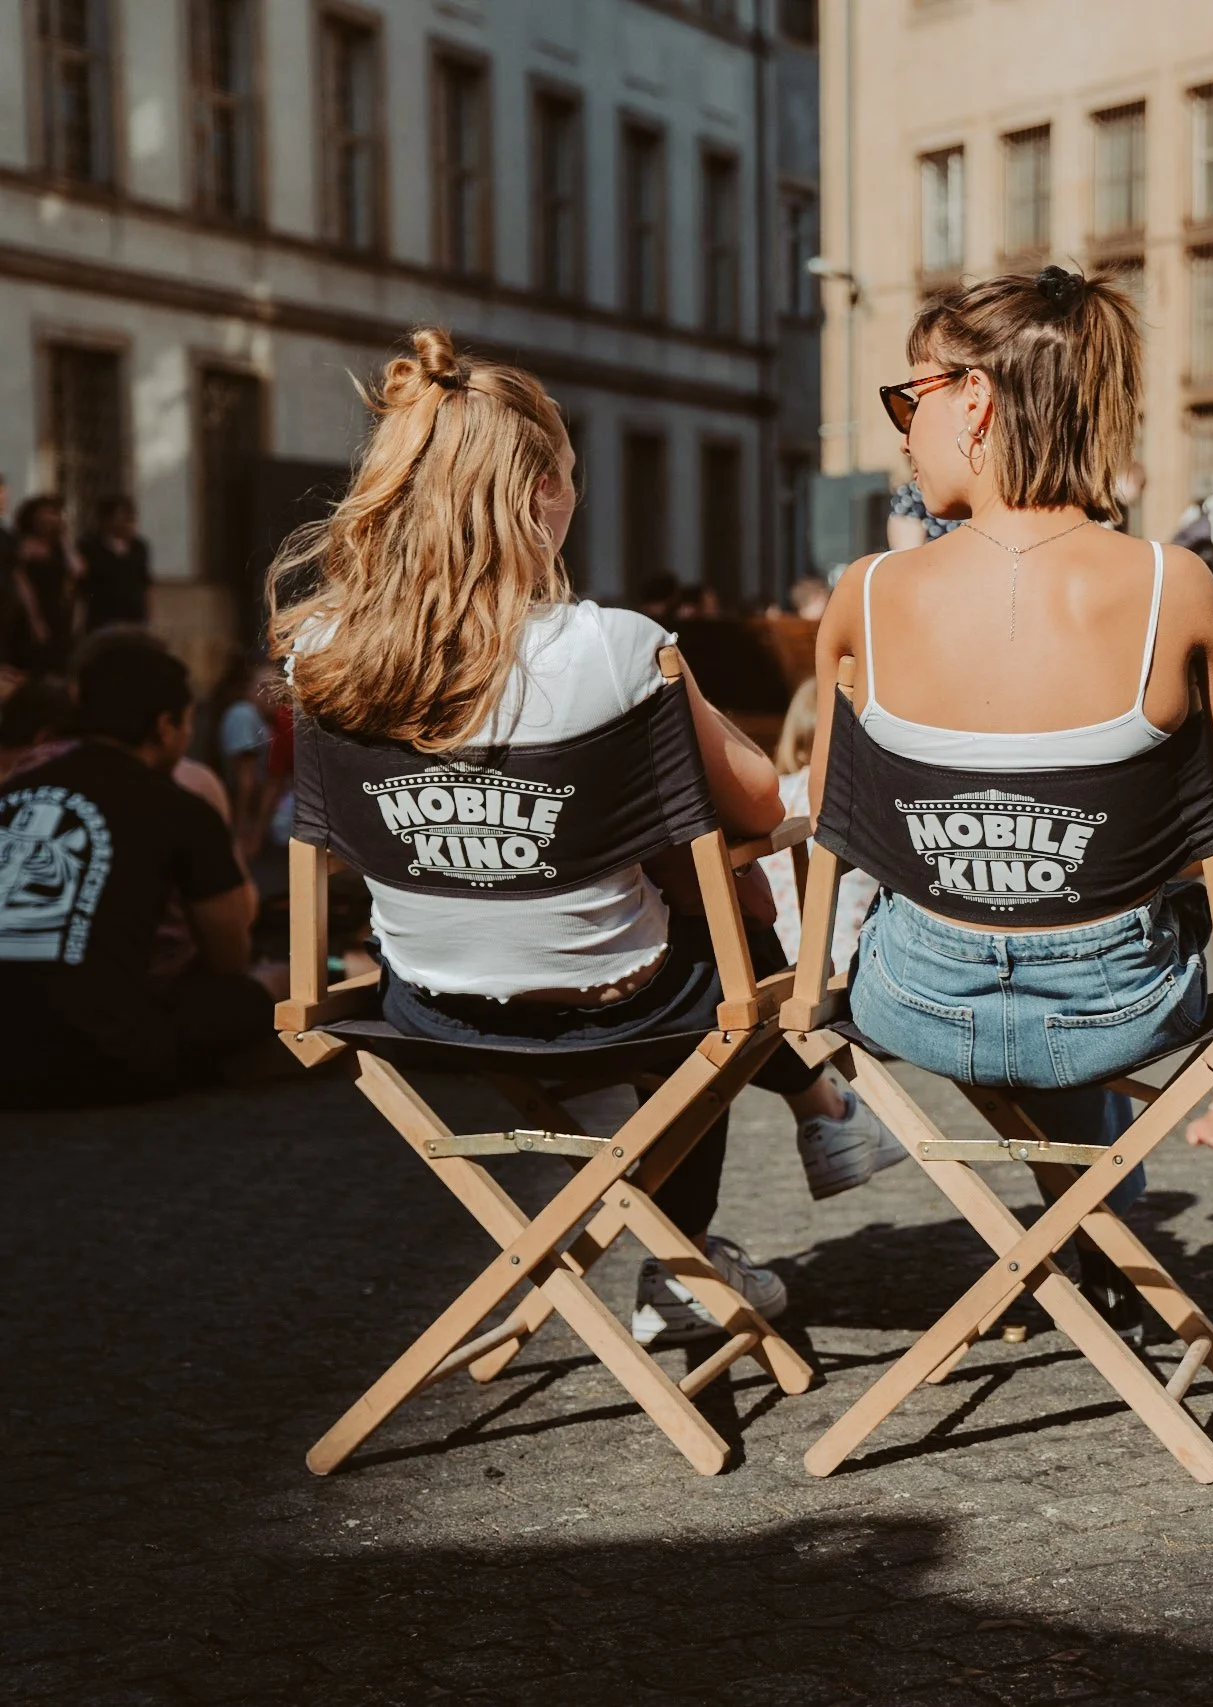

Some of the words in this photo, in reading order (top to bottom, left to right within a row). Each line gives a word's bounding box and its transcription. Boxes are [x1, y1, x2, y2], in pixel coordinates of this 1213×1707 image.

[377, 786, 563, 833] MOBILE
[413, 833, 539, 869] KINO
[905, 812, 1095, 860] MOBILE
[937, 856, 1066, 892] KINO
